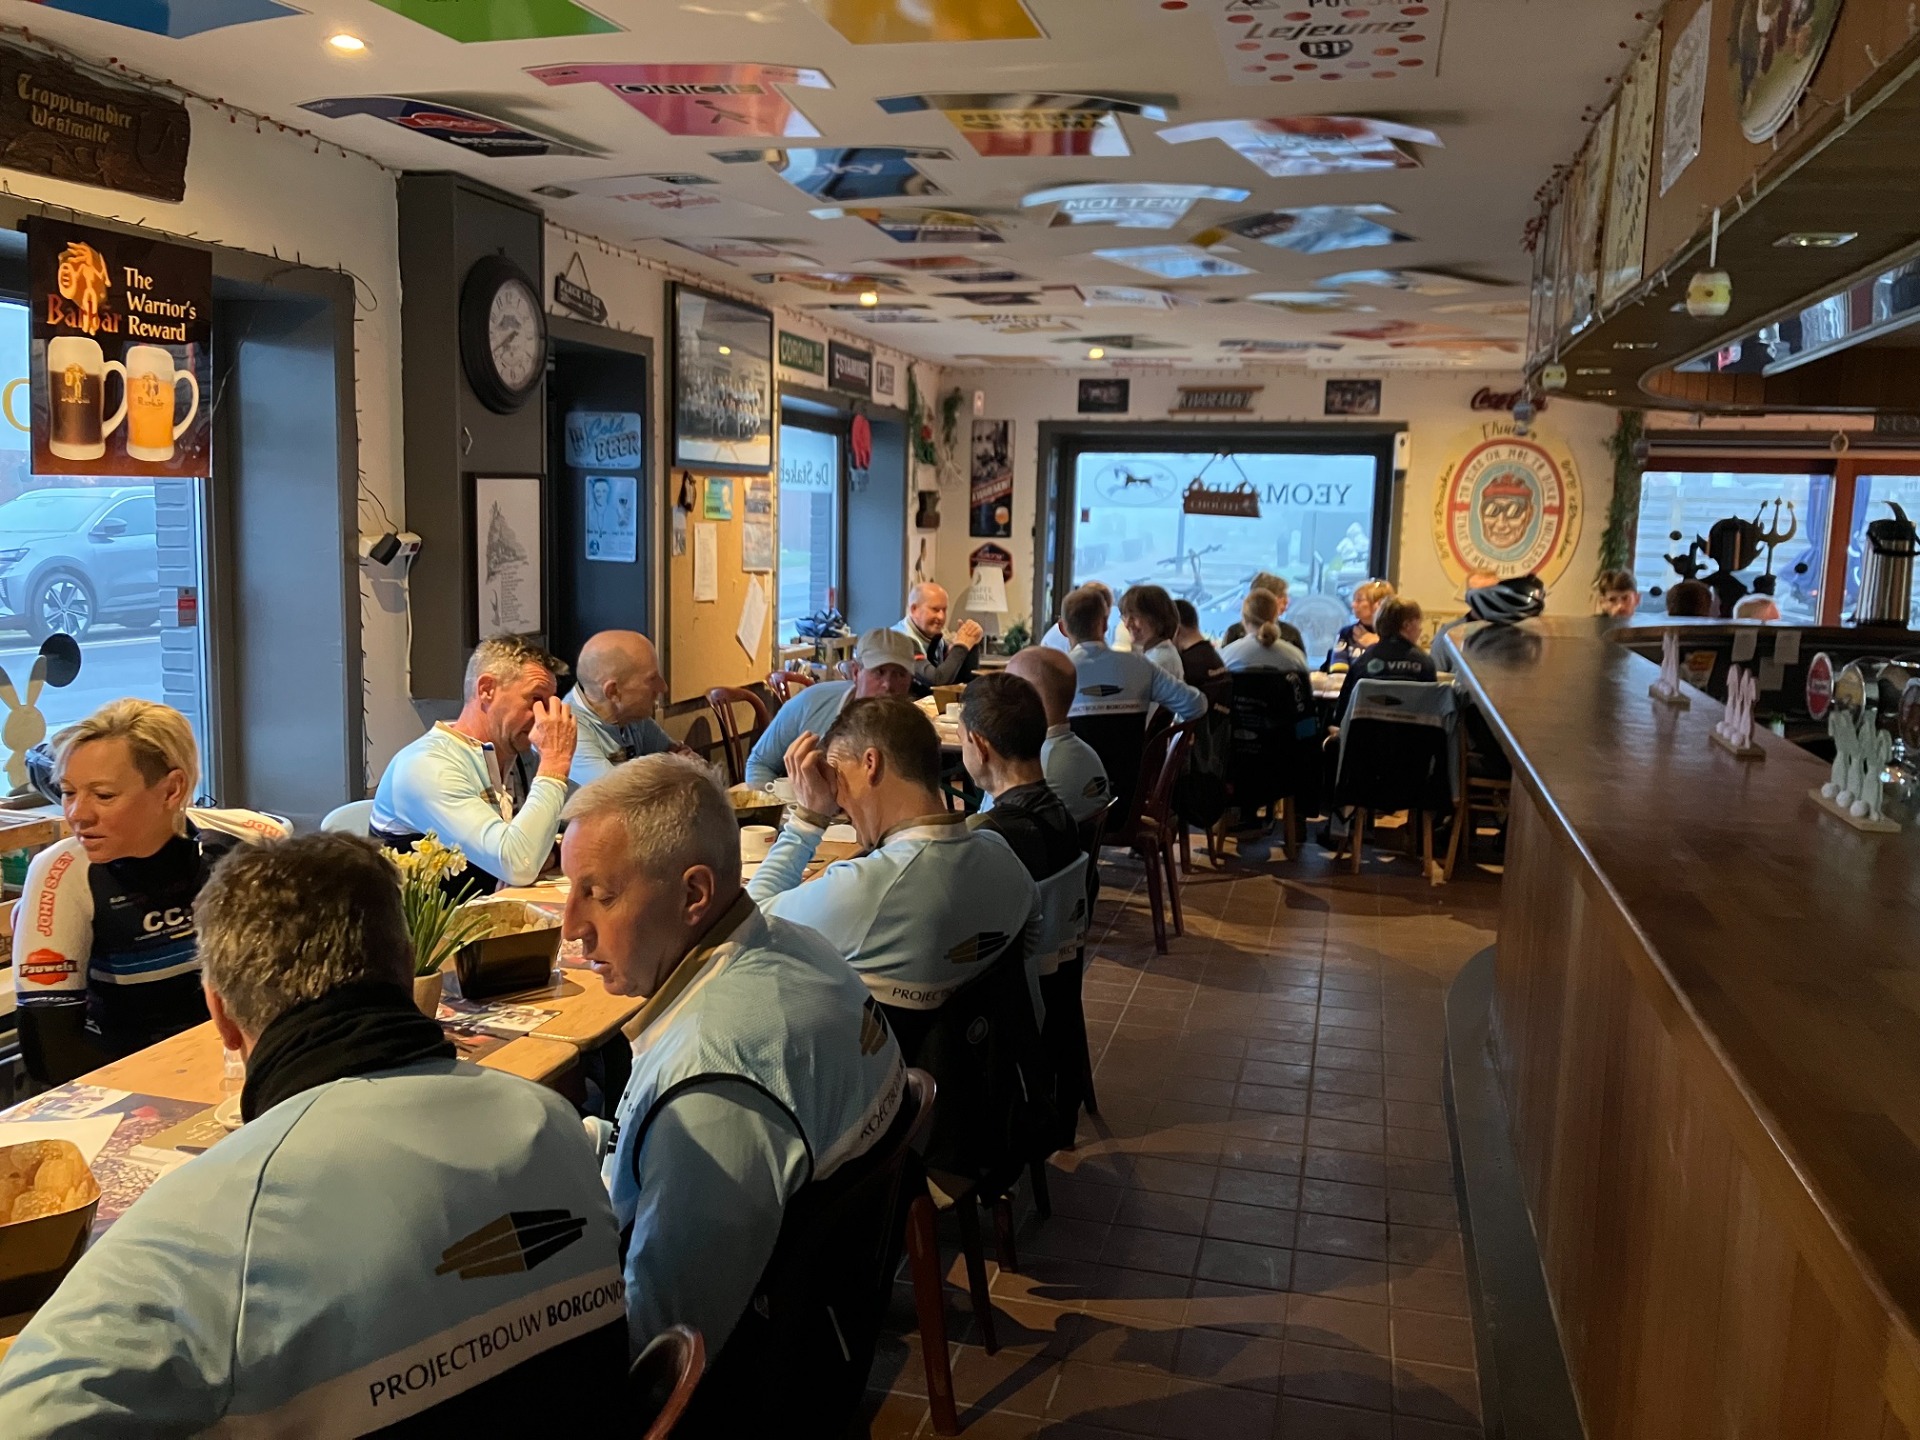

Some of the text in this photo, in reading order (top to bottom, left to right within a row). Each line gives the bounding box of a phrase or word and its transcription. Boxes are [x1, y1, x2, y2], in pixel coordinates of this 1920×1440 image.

[1244, 21, 1416, 41] Lejeune
[31, 104, 111, 144] Westmalle
[1064, 199, 1189, 210] MOLTENI
[123, 266, 154, 291] The
[126, 290, 197, 321] Warrior's
[127, 315, 187, 342] Reward
[780, 335, 814, 370] CORONA
[594, 430, 640, 463] BEER
[45, 851, 75, 889] SAEY
[37, 890, 56, 937] JOHN
[21, 963, 75, 975] Pauwels
[369, 1279, 627, 1407] PROJECTBOUW BORGONJO
